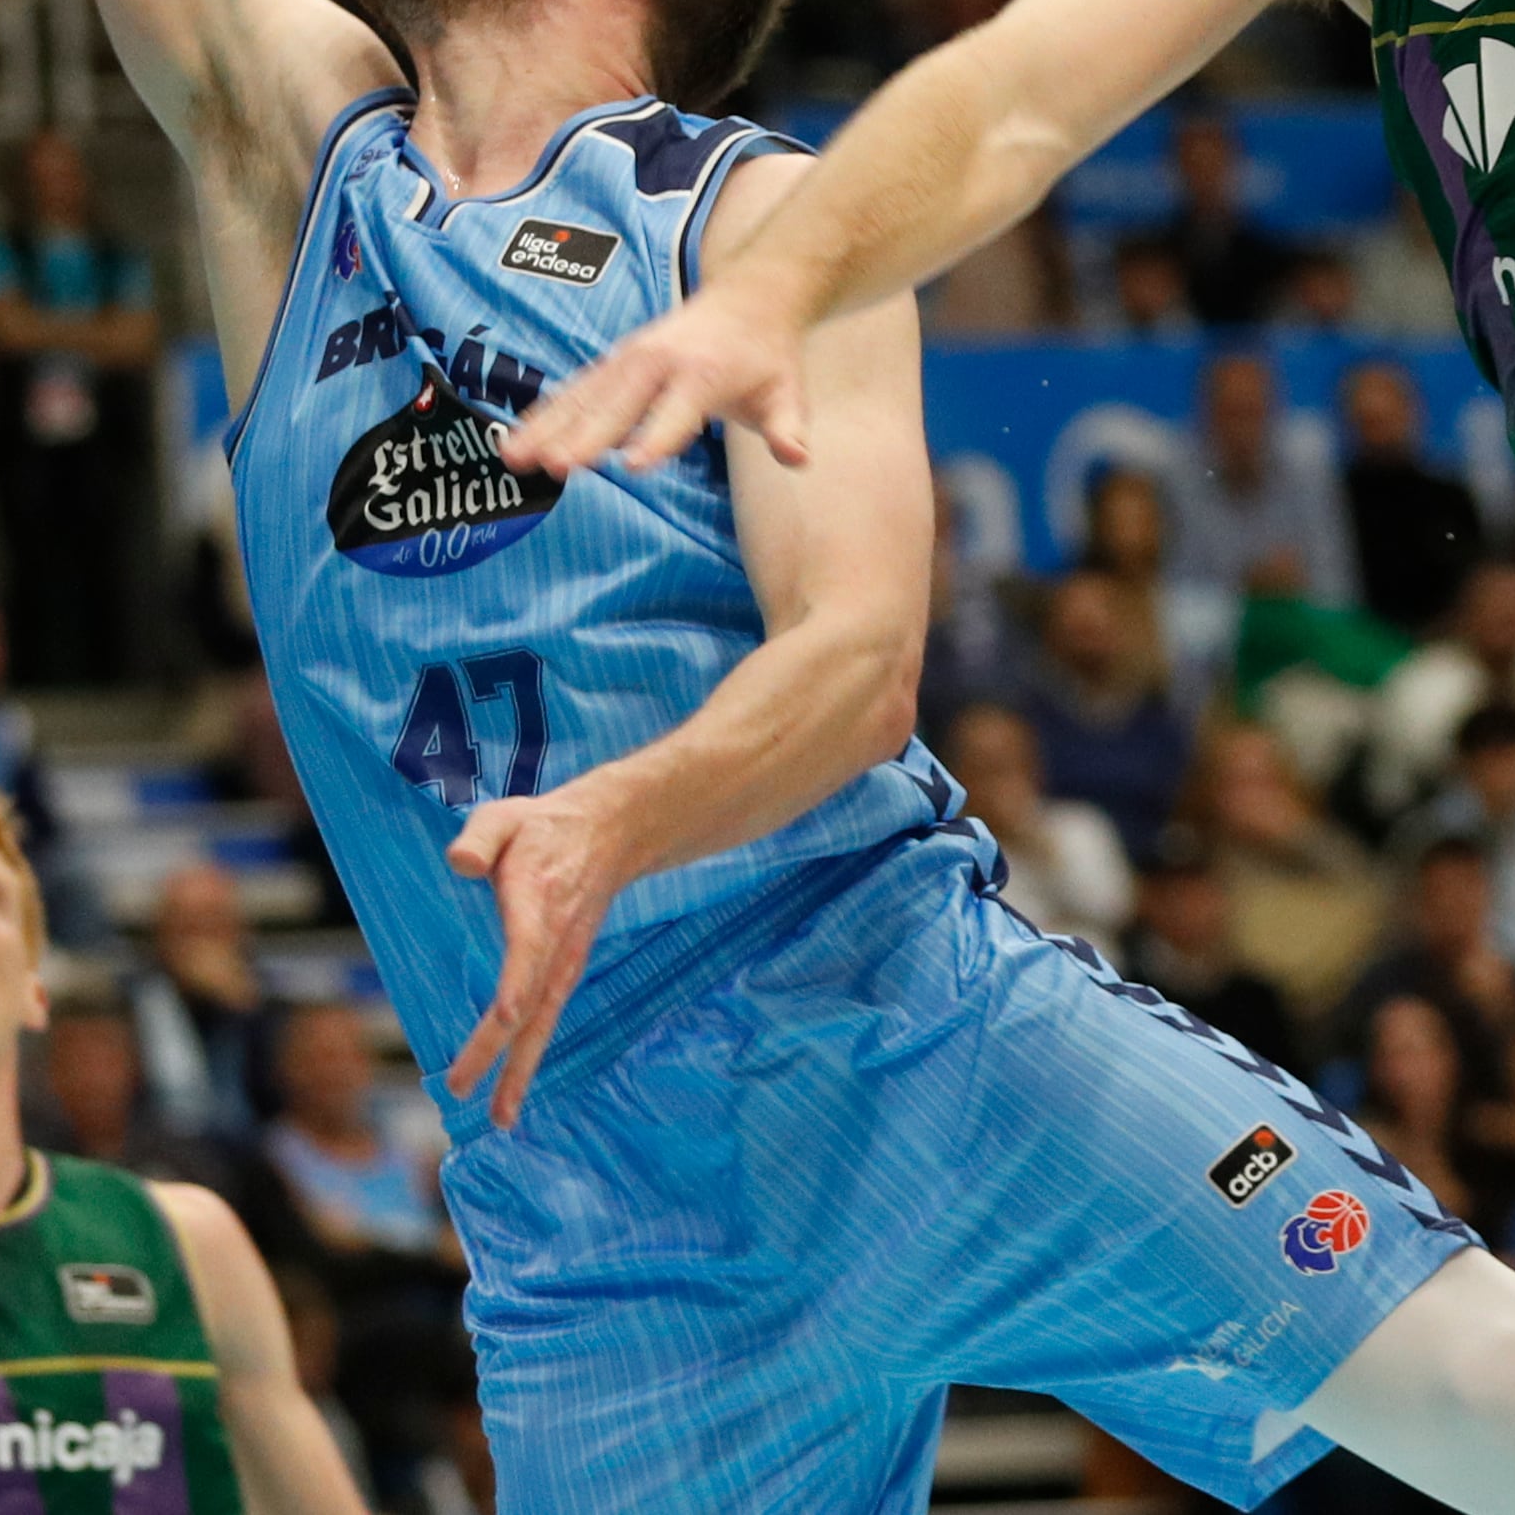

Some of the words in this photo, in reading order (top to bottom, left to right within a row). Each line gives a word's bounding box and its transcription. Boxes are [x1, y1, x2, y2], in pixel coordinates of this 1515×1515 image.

[511, 249, 597, 279] endesa
[518, 232, 560, 254] liga
[363, 464, 524, 531] Galicia
[418, 520, 471, 569] 0,0
[390, 646, 551, 808] 47
[1228, 1148, 1279, 1198] acb
